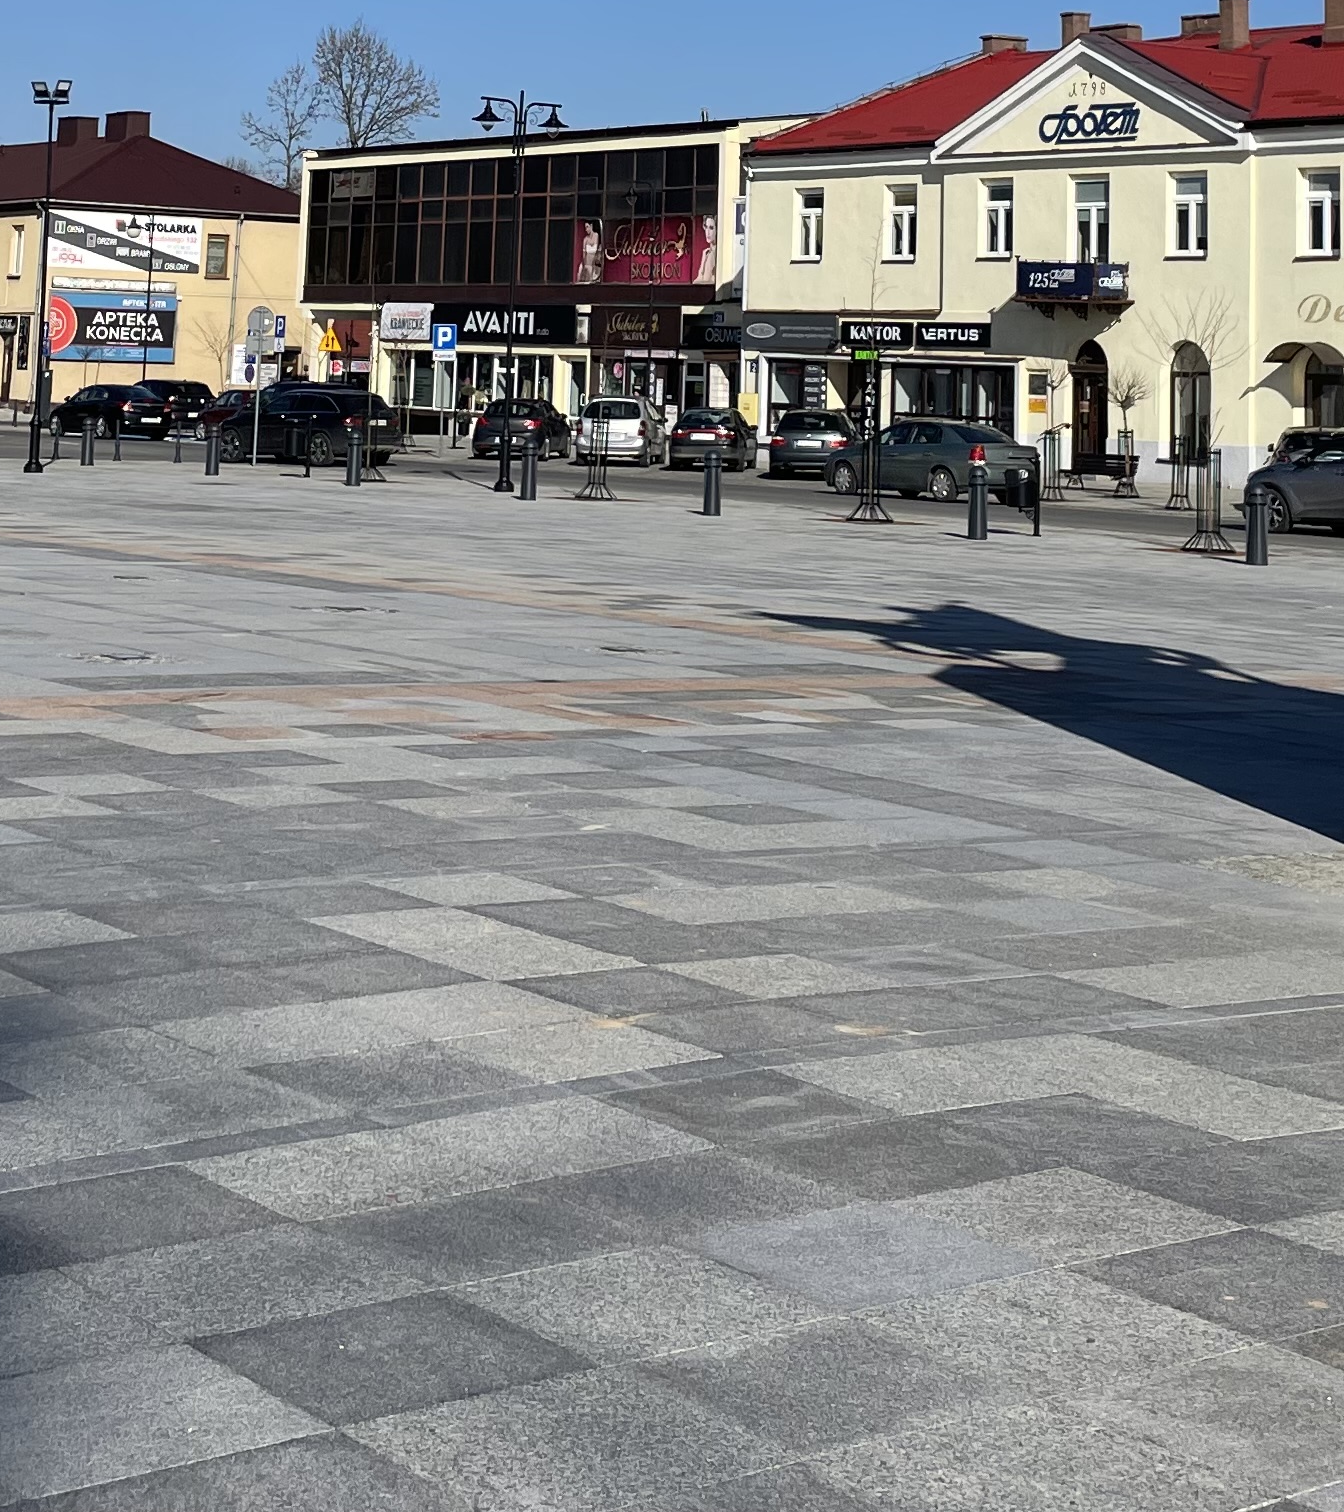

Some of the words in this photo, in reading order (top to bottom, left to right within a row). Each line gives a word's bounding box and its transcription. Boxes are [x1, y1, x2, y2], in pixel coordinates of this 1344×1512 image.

[92, 311, 159, 327] APTEKA
[463, 310, 535, 335] AVANTI
[85, 325, 164, 342] KONECKA
[437, 326, 453, 347] P
[849, 325, 902, 341] KANTOR
